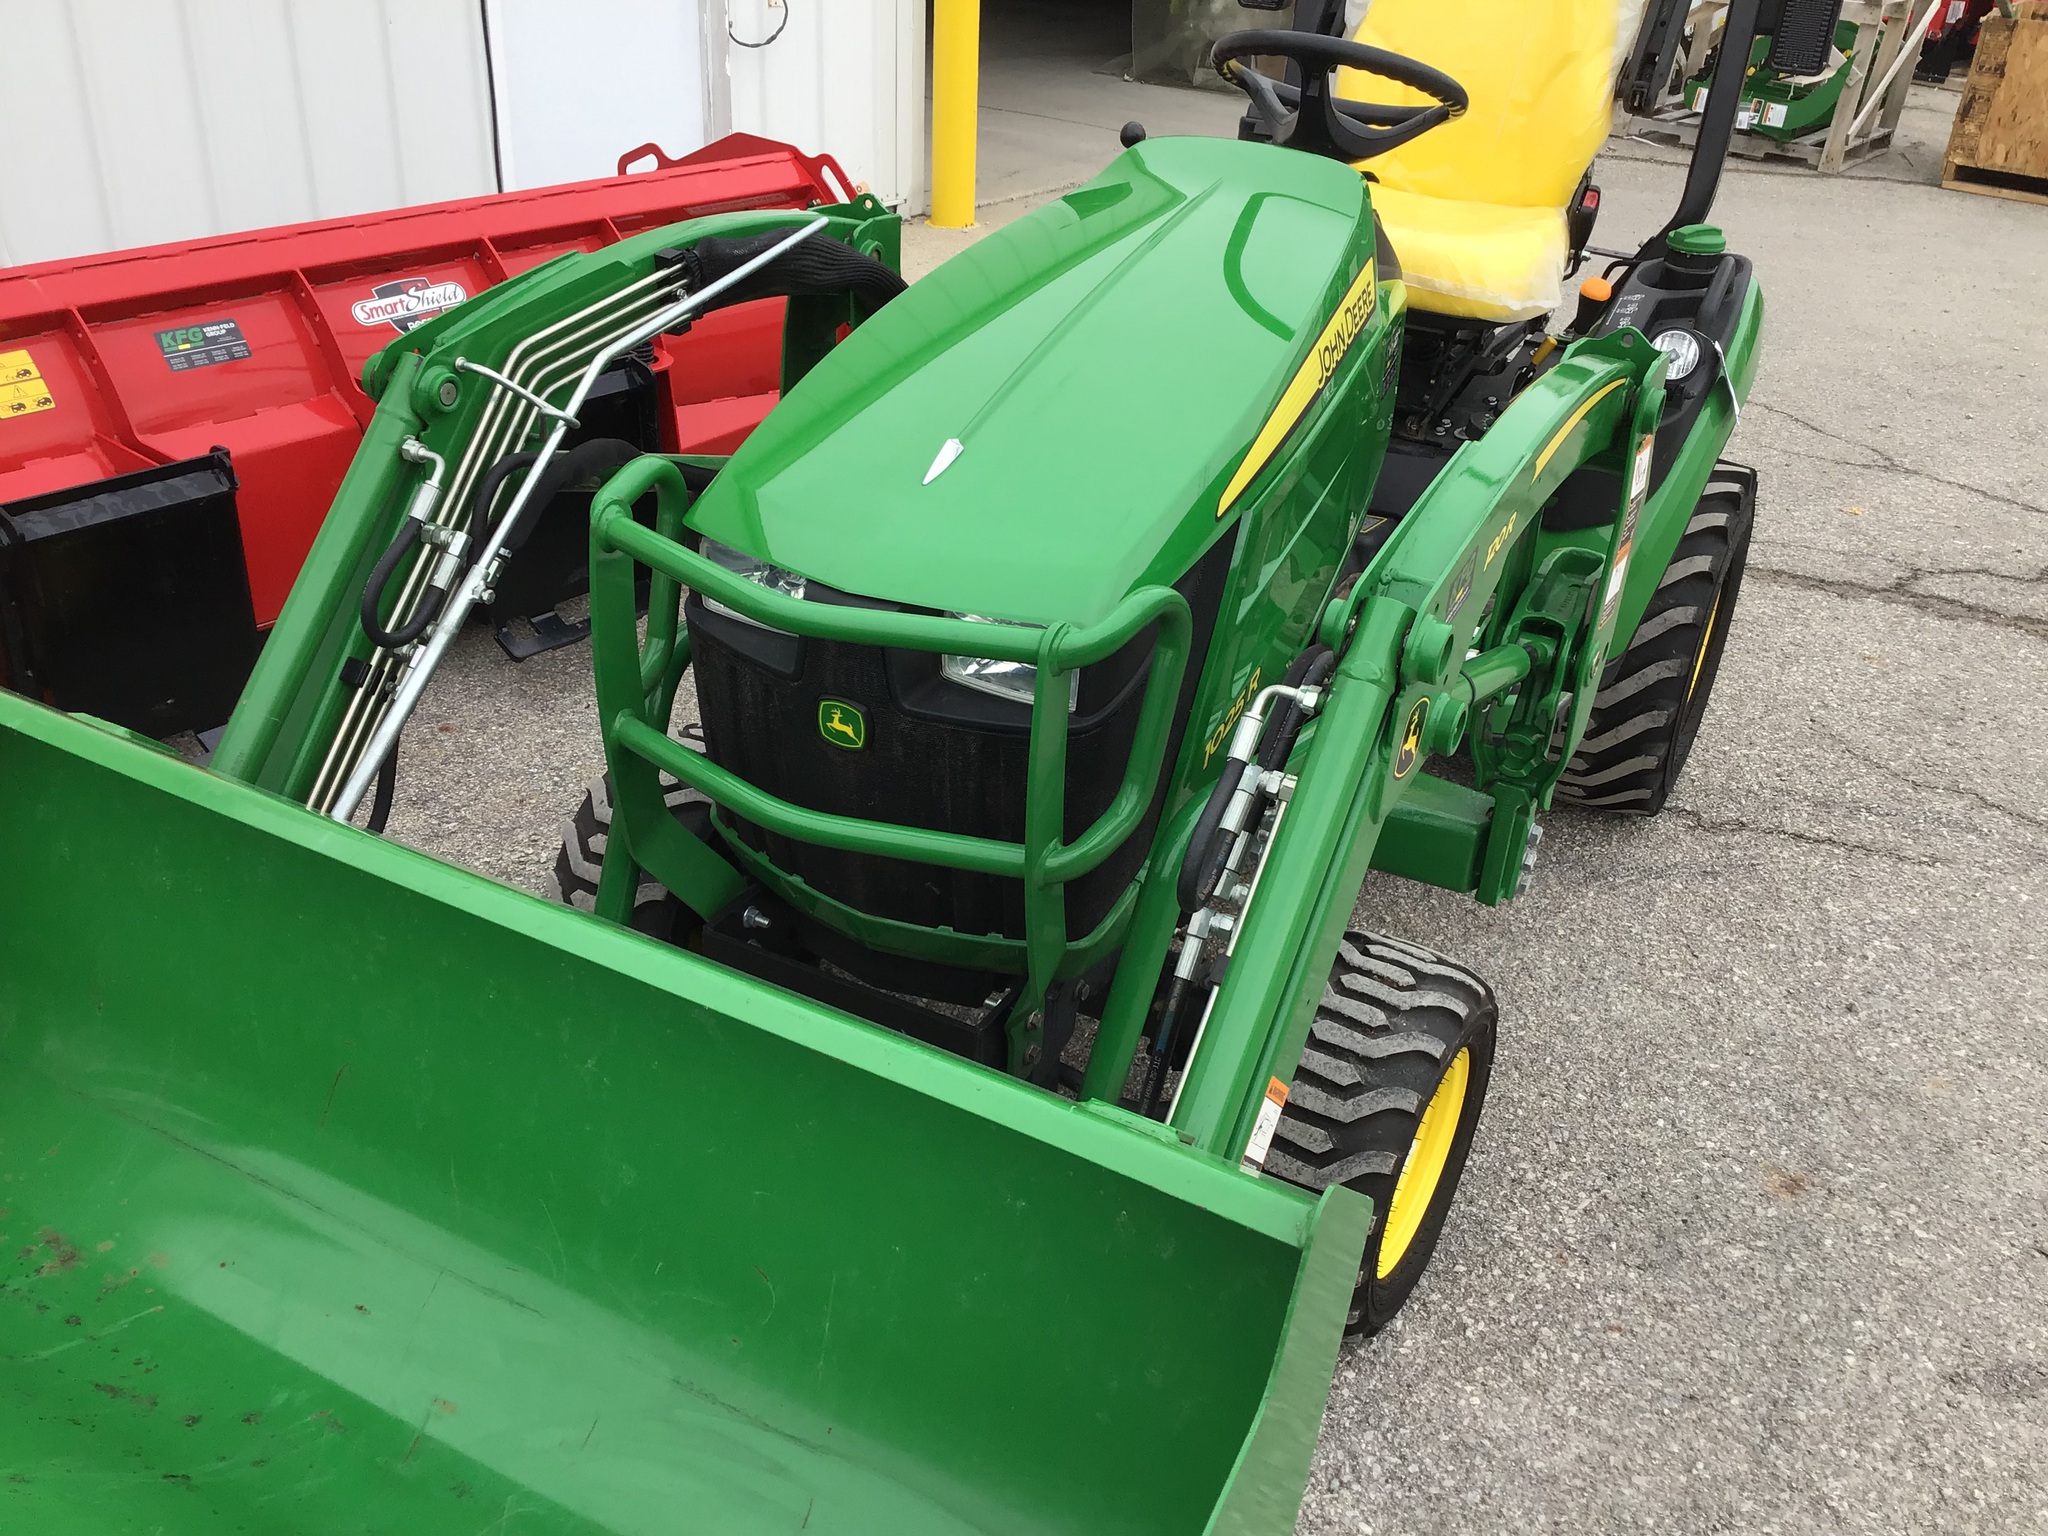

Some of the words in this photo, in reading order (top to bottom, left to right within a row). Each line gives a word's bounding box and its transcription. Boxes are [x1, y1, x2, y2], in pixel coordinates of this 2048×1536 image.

[160, 326, 204, 349] KFG
[1318, 322, 1346, 386] JOHN
[1344, 280, 1373, 338] DEERE
